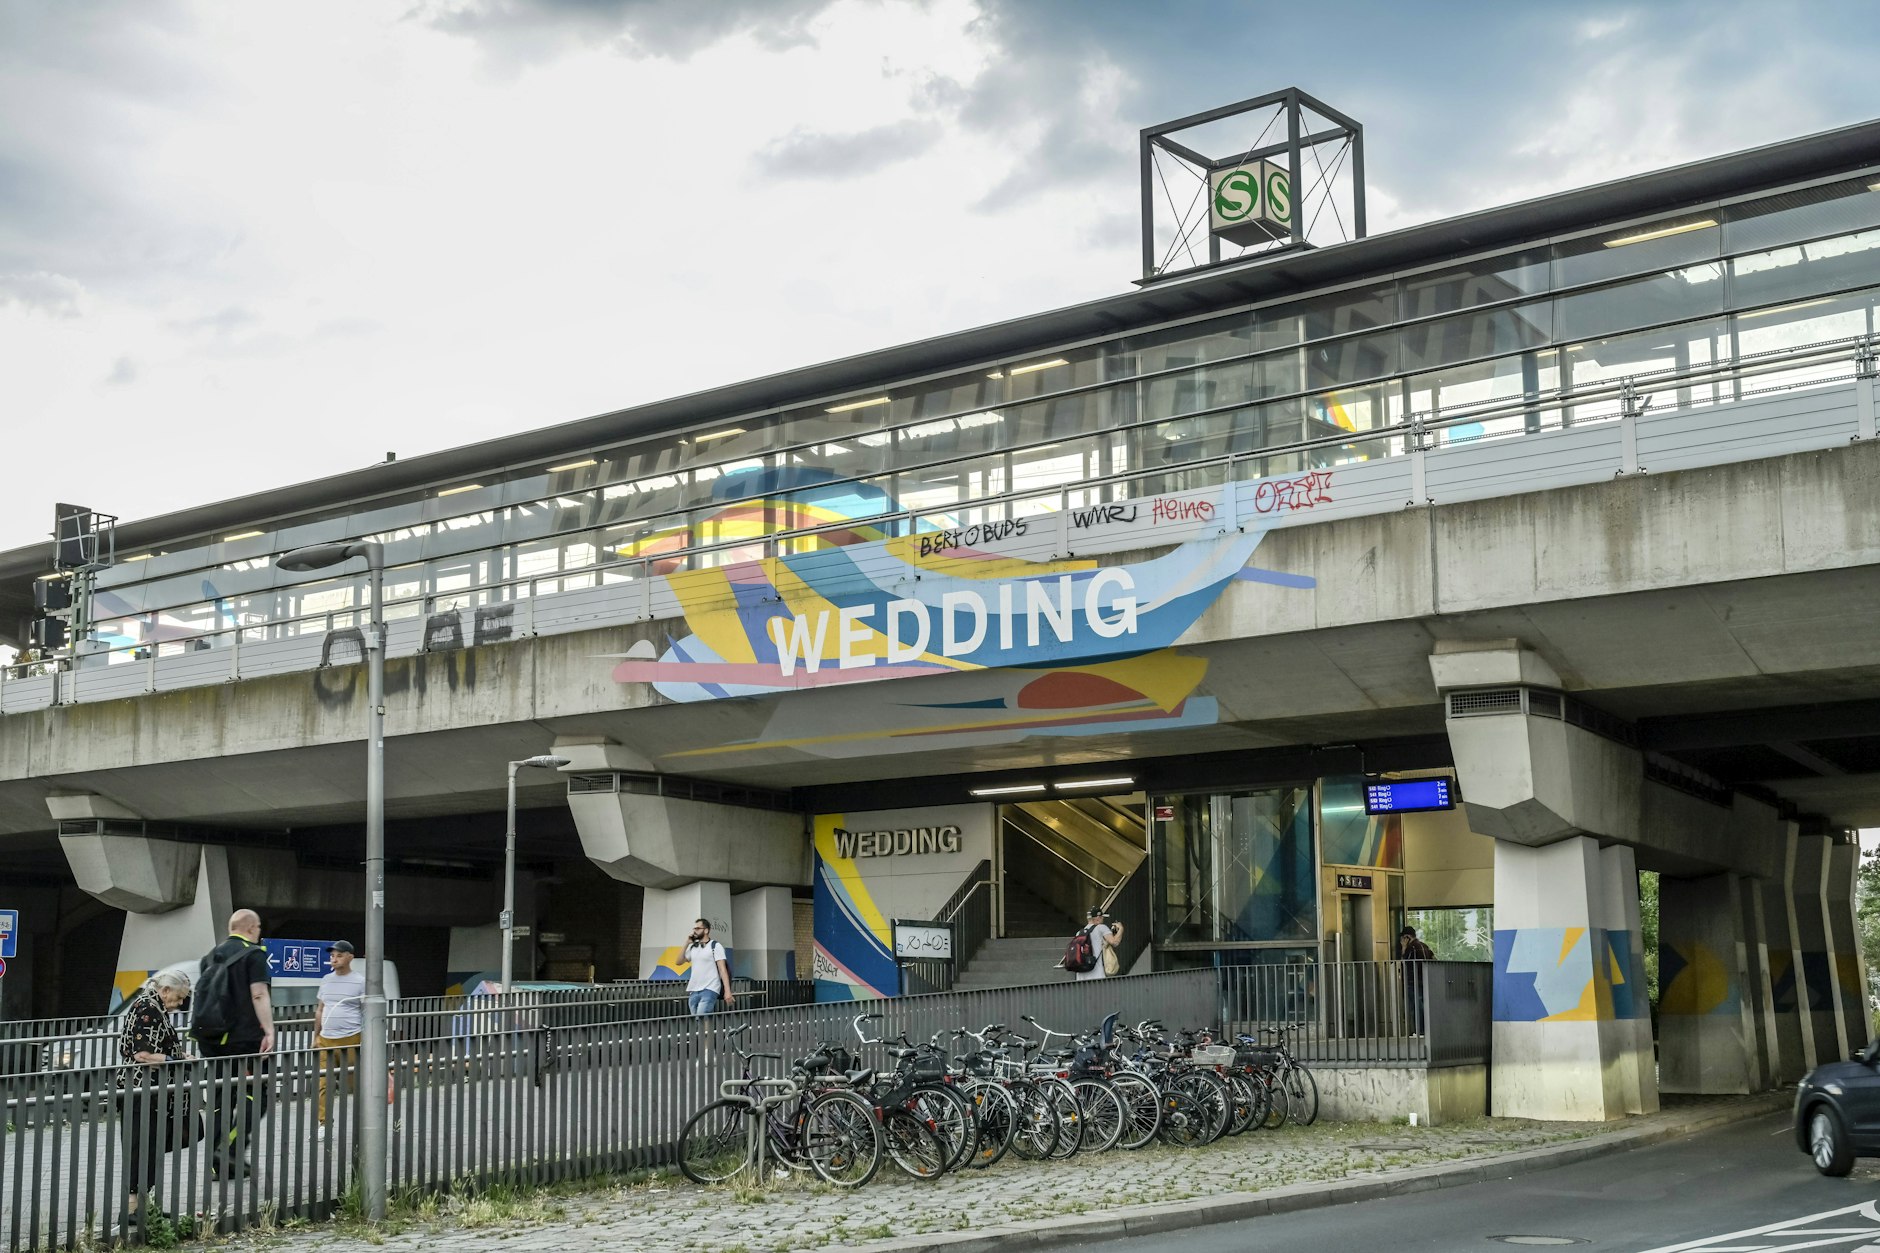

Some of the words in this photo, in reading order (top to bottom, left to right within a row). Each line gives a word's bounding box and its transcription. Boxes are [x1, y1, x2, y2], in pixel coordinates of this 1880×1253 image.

[1219, 173, 1254, 219] S
[1269, 174, 1291, 221] S
[772, 567, 1138, 677] WEDDING
[834, 826, 961, 859] WEDDING
